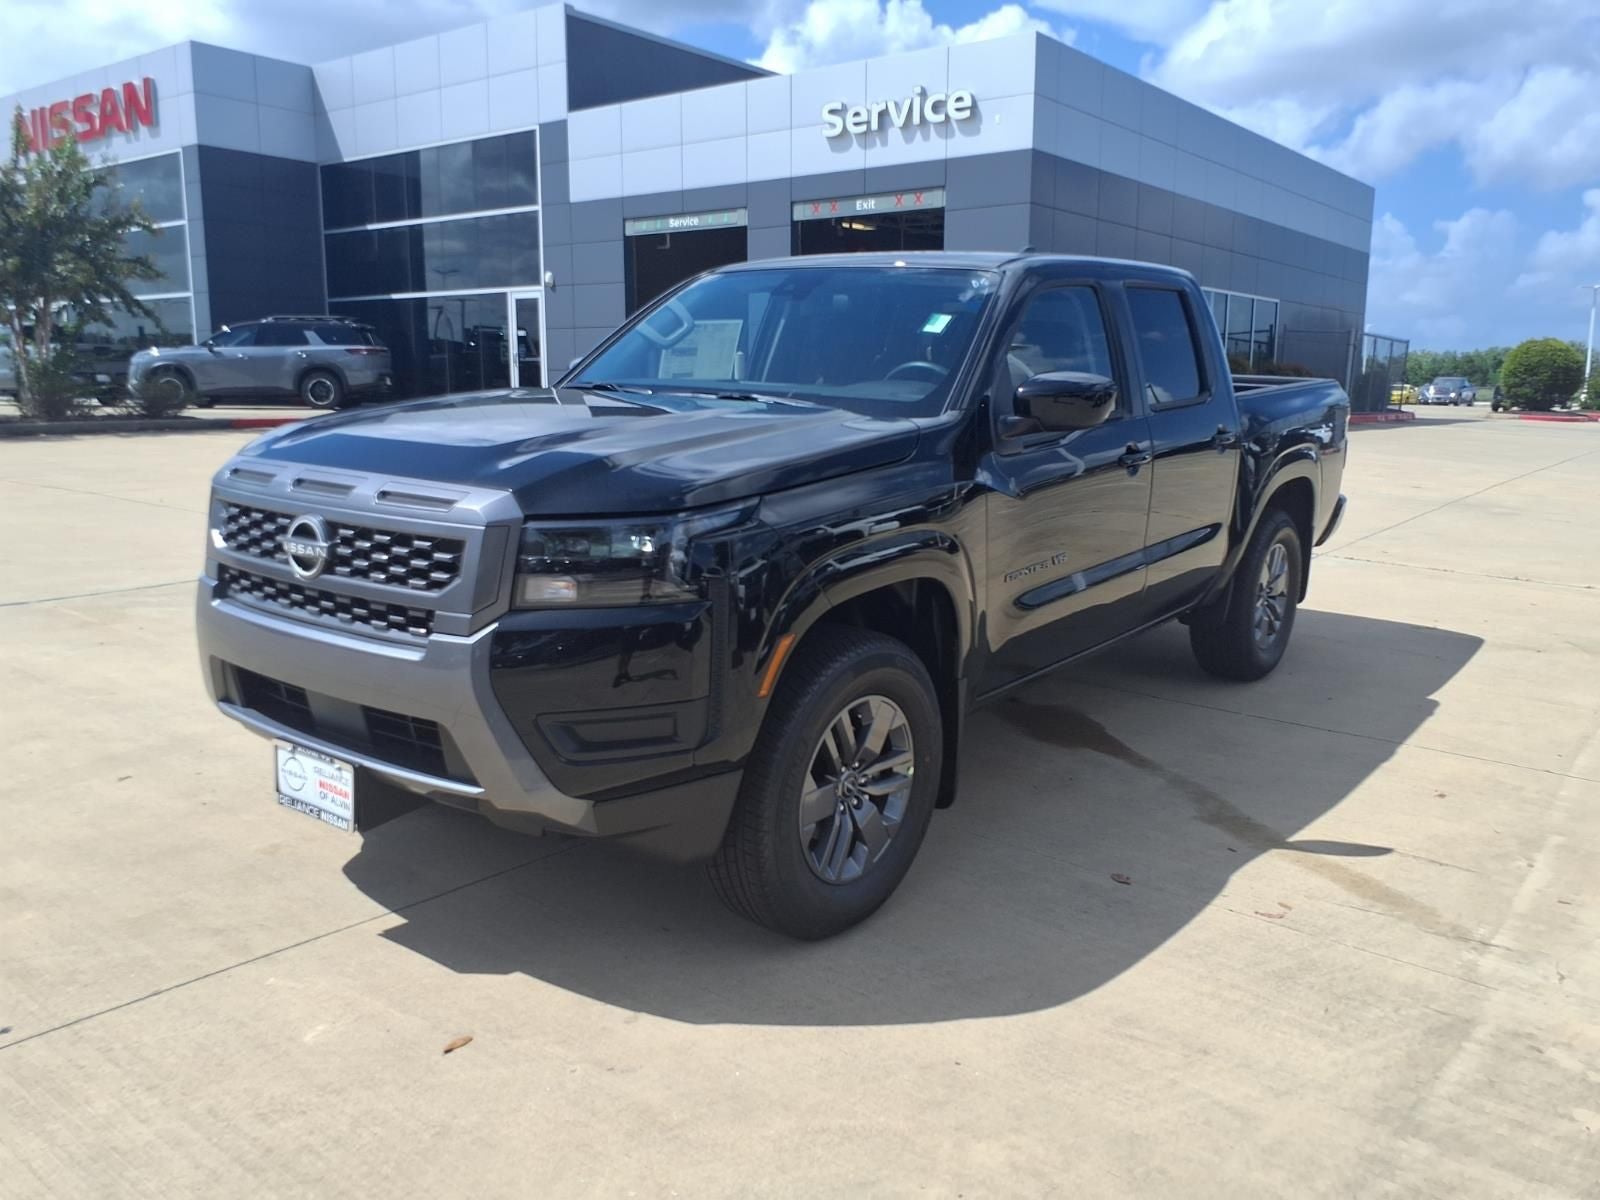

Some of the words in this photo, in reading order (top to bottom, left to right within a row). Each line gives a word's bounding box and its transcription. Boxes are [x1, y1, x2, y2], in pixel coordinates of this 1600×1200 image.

[16, 77, 155, 154] NISSAN
[821, 85, 974, 138] Service
[855, 199, 876, 211] Exit
[669, 216, 699, 228] Service
[319, 779, 350, 801] NISSAN
[319, 791, 329, 801] OF
[331, 795, 351, 811] ALVIN
[279, 795, 320, 817] RELIANCE
[320, 809, 348, 829] NISSAN
